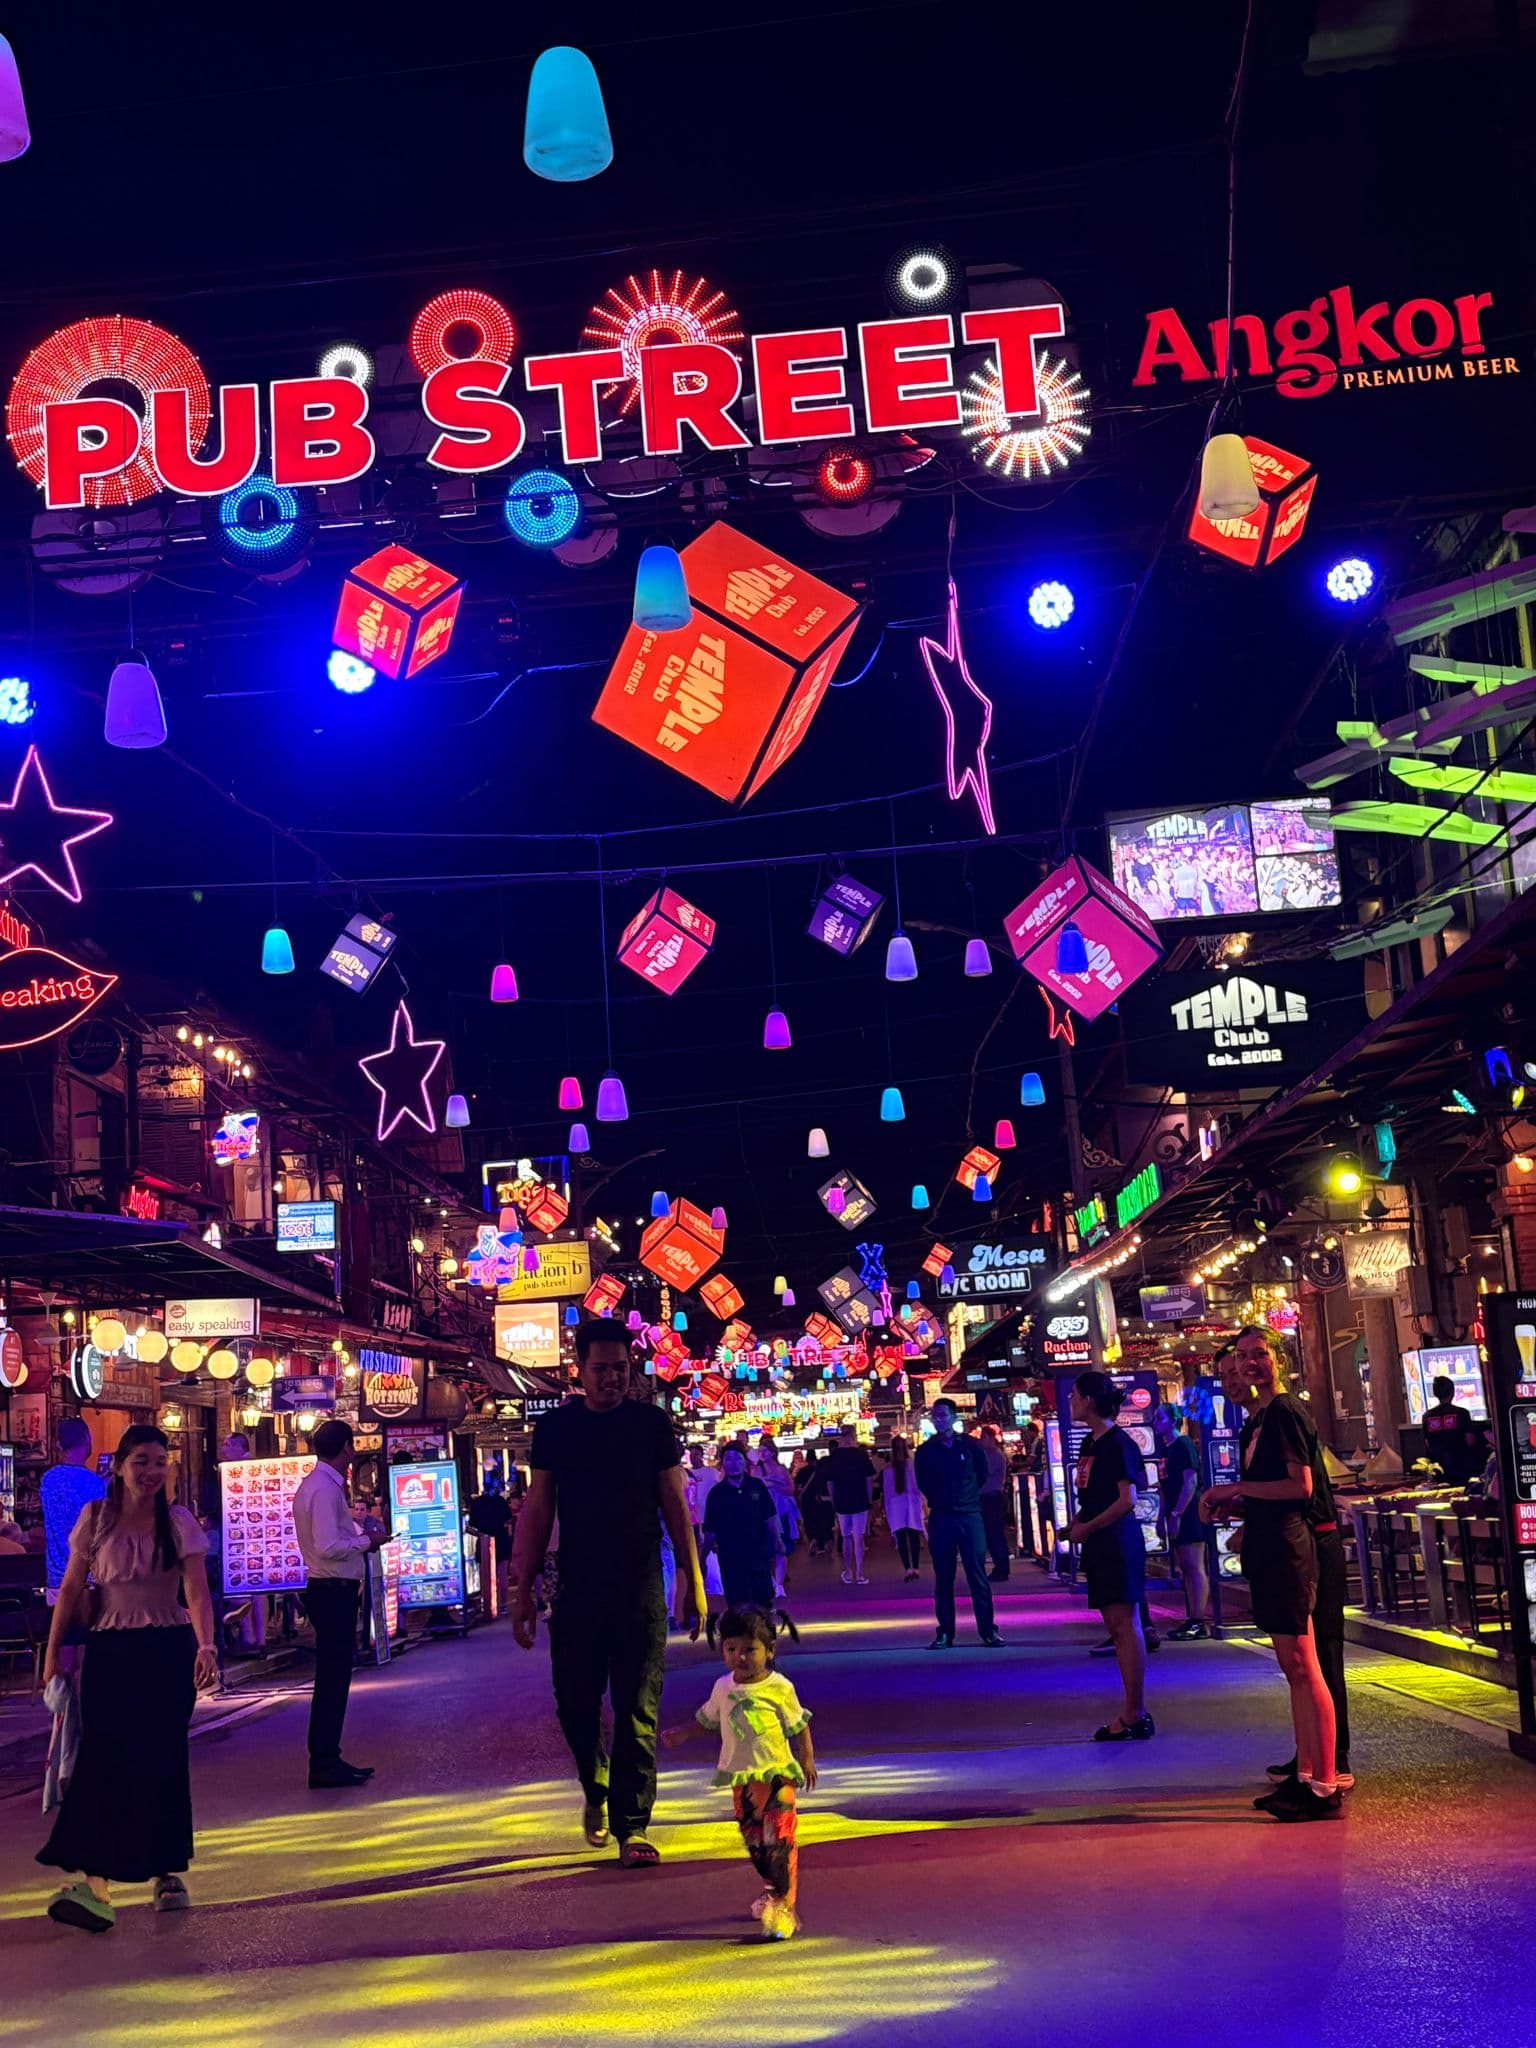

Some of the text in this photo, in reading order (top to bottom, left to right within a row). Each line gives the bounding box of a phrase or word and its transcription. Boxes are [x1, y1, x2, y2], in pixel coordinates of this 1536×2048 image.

[1132, 285, 1493, 399] Angkor
[1343, 356, 1520, 390] PREMIUM BEER
[45, 302, 1066, 509] PUB STREET
[1247, 450, 1295, 481] MPLE
[1209, 518, 1260, 540] TEMP
[382, 559, 430, 593] TEMPLE
[724, 563, 795, 621] TEMPLE
[765, 594, 797, 619] Club
[357, 599, 385, 660] TEMPLE
[653, 654, 686, 703] Club
[655, 633, 727, 753] TEMPLE
[1146, 813, 1208, 839] TEMPLE
[1016, 877, 1077, 937] TEMPLE
[330, 950, 370, 979] TEMPLE
[643, 933, 684, 977] TEMPLE
[1082, 937, 1123, 991] MPLE
[1171, 976, 1308, 1031] TEMPLE
[1214, 1028, 1270, 1048] Club
[1208, 1049, 1282, 1067] Est. 2002
[661, 1244, 700, 1275] TEMPLE
[968, 1244, 1046, 1272] Mesa
[974, 1272, 1026, 1291] ROOM
[168, 1317, 252, 1334] easy speaking
[1044, 1340, 1092, 1353] Rachan
